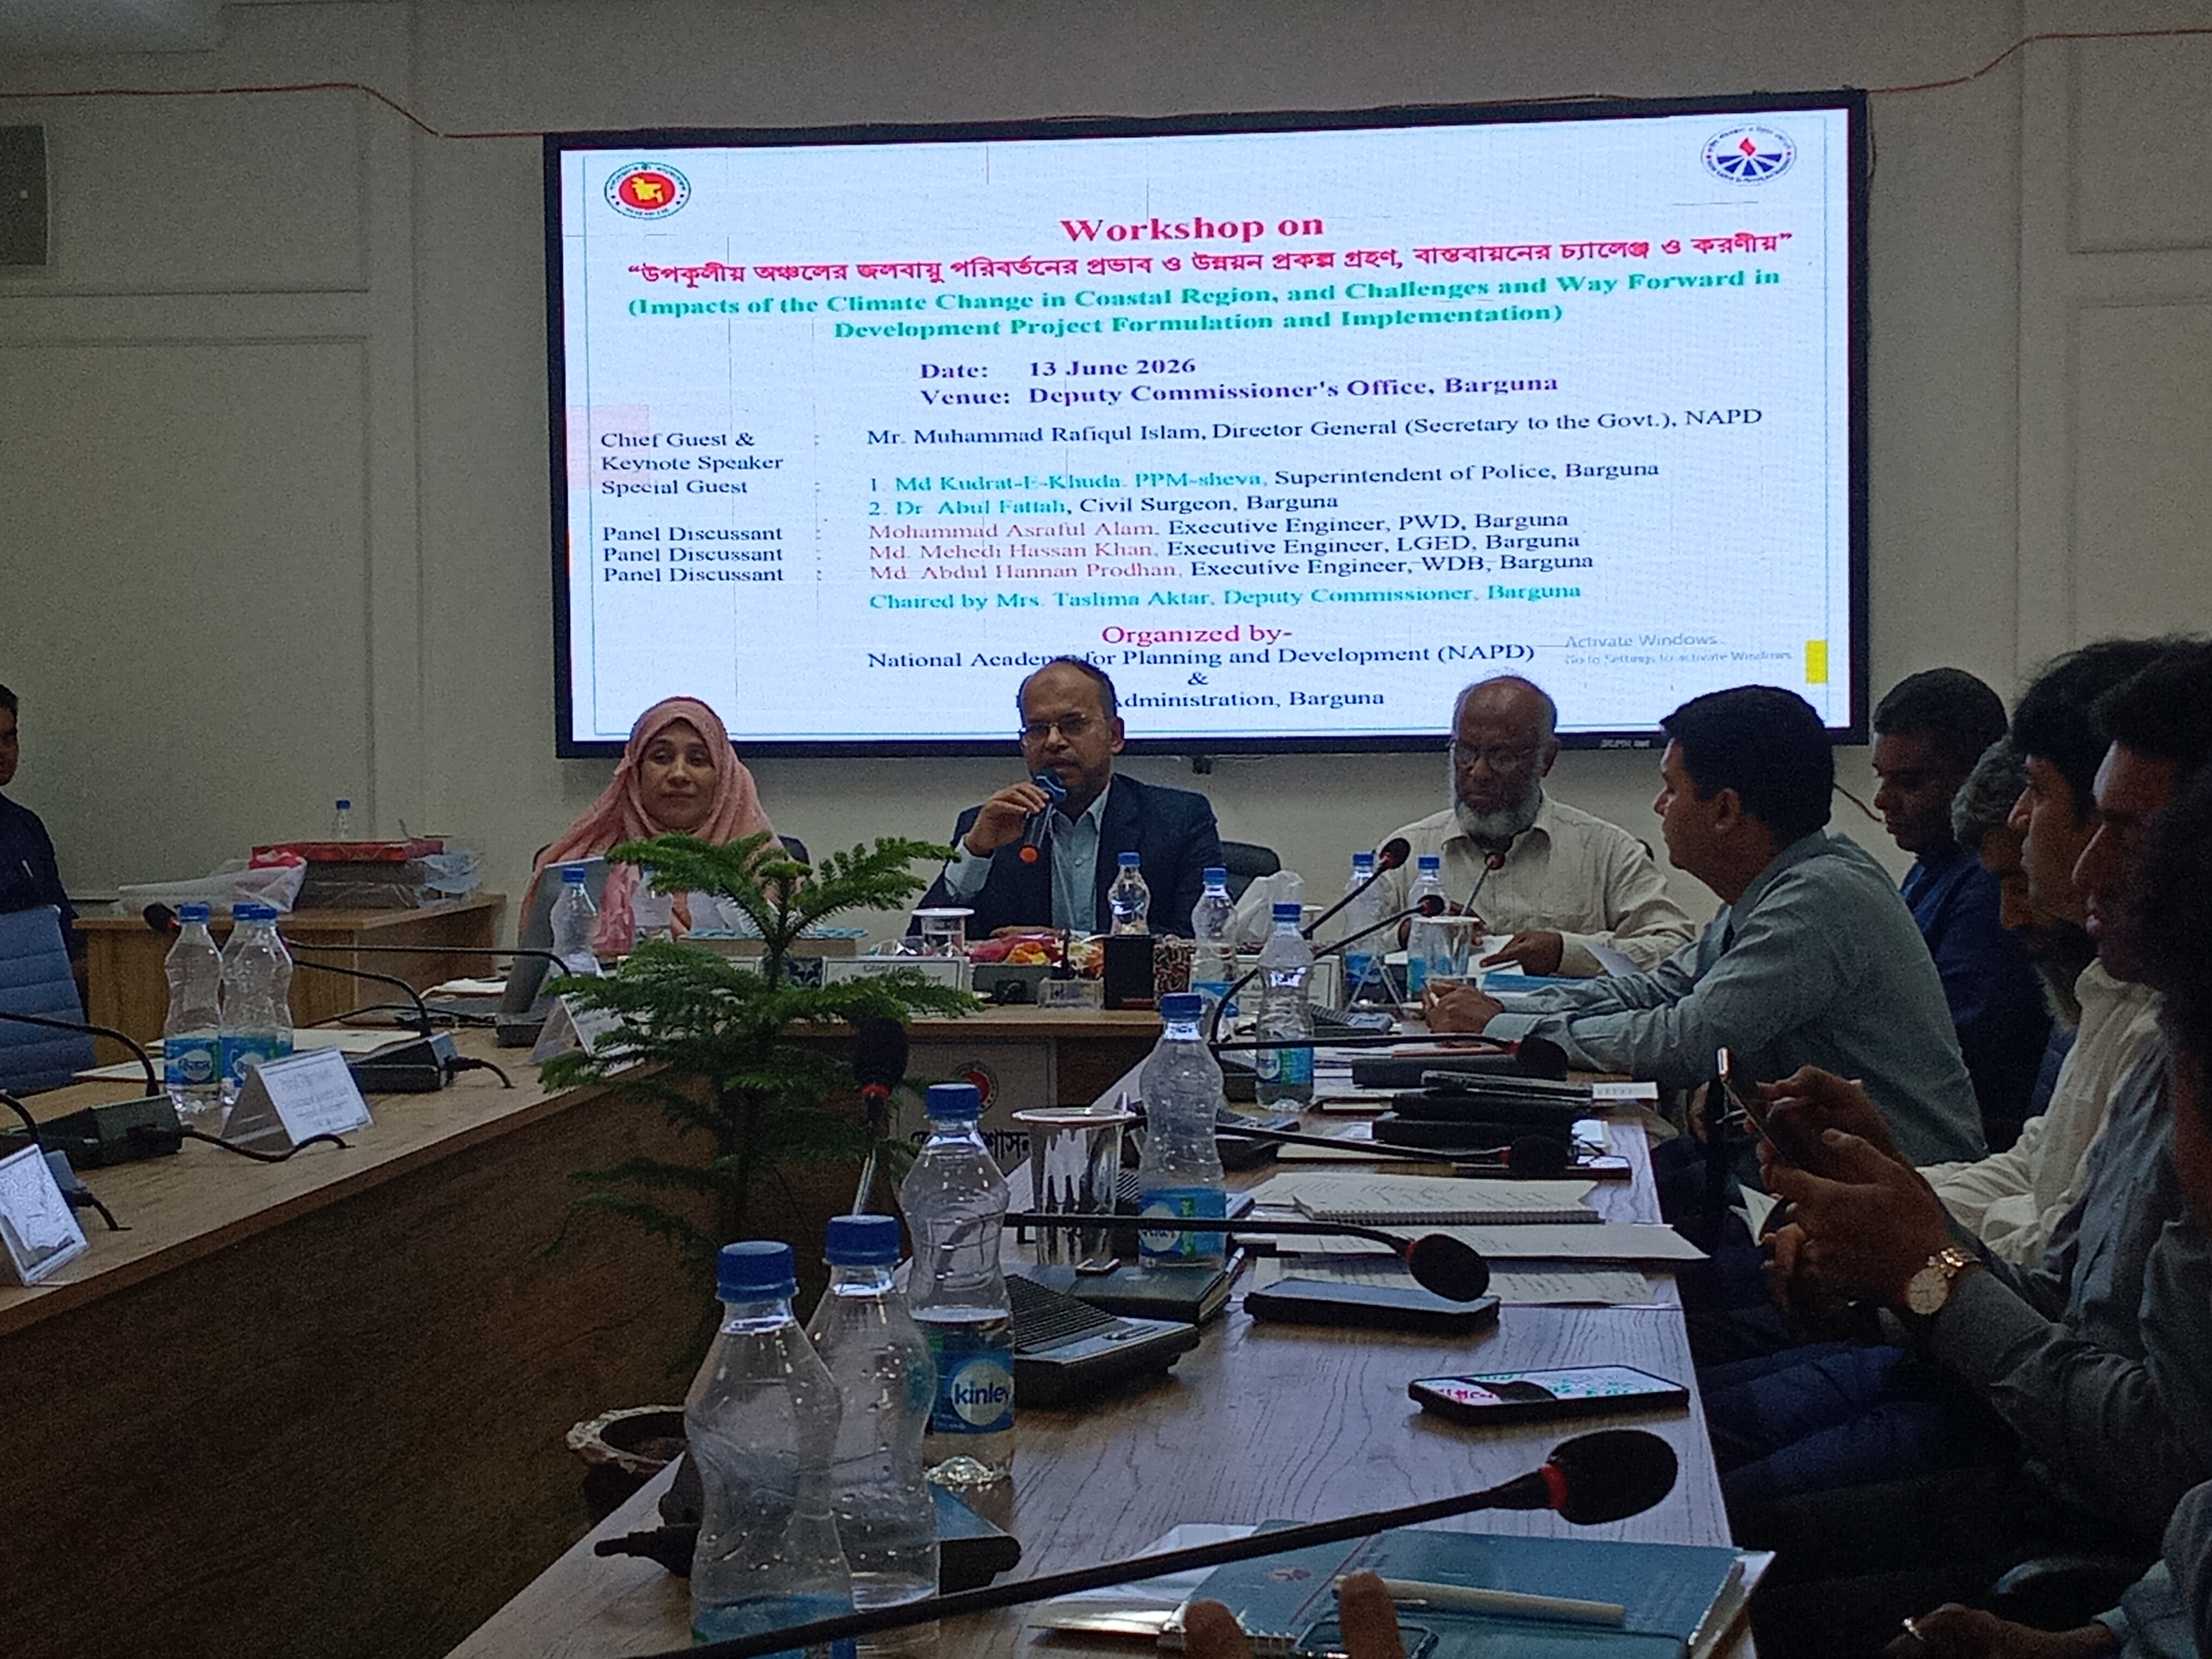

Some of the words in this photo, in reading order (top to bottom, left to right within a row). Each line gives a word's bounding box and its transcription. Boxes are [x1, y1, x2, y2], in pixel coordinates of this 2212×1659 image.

[1059, 216, 1264, 243] Workshop
[1277, 218, 1324, 237] on
[752, 264, 850, 282] অঞ্চলের
[855, 261, 946, 284] জলবায়ু
[949, 254, 1079, 278] পরিবর্তনের
[1086, 256, 1154, 276] প্রভাব
[1161, 256, 1182, 272] ও
[1191, 251, 1265, 272] উন্নয়ন
[1271, 252, 1337, 271] প্রকল্প
[1343, 248, 1403, 269] গ্রহণ,
[1412, 244, 1553, 265] বাস্তবায়নের
[1559, 241, 1650, 261] চ্যালেঞ্জ
[1660, 239, 1682, 255] ও
[627, 298, 741, 319] (Impacts
[747, 297, 775, 314] of
[779, 297, 819, 314] the
[826, 295, 928, 313] Climate
[934, 293, 1034, 313] Change
[1041, 292, 1068, 308] in
[1073, 289, 1173, 307] Coastal
[1180, 286, 1279, 307] Region,
[1287, 284, 1336, 302] and
[1344, 280, 1490, 301] Challenges
[1497, 277, 1548, 294] and
[1555, 275, 1619, 295] Way
[1628, 269, 1746, 291] Forward
[1754, 268, 1782, 285] in
[834, 320, 1002, 341] Development
[1009, 318, 1104, 338] Project
[1111, 313, 1275, 333] Formulation
[1283, 311, 1333, 329] and
[1341, 304, 1564, 330] Implementation)
[921, 363, 988, 379] Date:
[1030, 361, 1057, 377] 13
[1065, 361, 1128, 376] June
[1136, 358, 1196, 375] 2026
[920, 389, 1009, 406] Venue:
[1029, 388, 1122, 407] Deputy
[1130, 381, 1339, 402] Commissioner's
[1347, 379, 1435, 396] Office,
[1445, 377, 1558, 395] Barguna
[914, 427, 1044, 445] Muhammad
[1051, 426, 1131, 445] Rafiqul
[1141, 425, 1207, 441] Islam,
[1212, 423, 1303, 439] Director
[1310, 419, 1397, 436] General
[1405, 418, 1519, 436] (Secretary
[1528, 417, 1549, 430] to
[1556, 414, 1590, 430] the
[1597, 413, 1677, 429] Govt.),
[1684, 408, 1763, 426] NAPD
[601, 433, 662, 448] Chief
[666, 433, 727, 448] Guest
[735, 432, 755, 447] &
[602, 456, 691, 473] Keynote
[698, 455, 784, 473] Speaker
[1275, 467, 1442, 488] Superintendent
[1450, 465, 1476, 481] of
[1481, 464, 1557, 480] Police,
[1565, 463, 1660, 480] Barguna
[602, 479, 678, 498] Special
[686, 479, 748, 494] Guest
[937, 499, 990, 515] Abul
[999, 499, 1072, 515] Fattah,
[1079, 497, 1133, 513] Civil
[1141, 497, 1238, 515] Surgeon,
[1246, 495, 1339, 512] Barguna
[602, 526, 661, 542] Panel
[668, 526, 783, 541] Discussant
[869, 523, 998, 539] Mohammad
[1006, 522, 1085, 537] Asraful
[1168, 518, 1278, 535] Executive
[1285, 517, 1391, 536] Engineer,
[1399, 514, 1467, 531] PWD,
[1474, 513, 1568, 531] Barguna
[603, 547, 660, 562] Panel
[668, 546, 783, 562] Discussant
[921, 541, 1001, 559] Mehedi
[1010, 543, 1086, 558] Hassan
[1167, 539, 1276, 556] Executive
[1283, 539, 1390, 557] Engineer,
[1397, 535, 1477, 552] LGED,
[1486, 534, 1580, 552] Barguna
[604, 567, 661, 582] Panel
[670, 567, 784, 582] Discussant
[921, 565, 987, 580] Abdul
[996, 564, 1077, 578] Hannan
[1191, 559, 1300, 576] Executive
[1307, 558, 1413, 577] Engineer,
[1420, 556, 1491, 573] WDB,
[1500, 554, 1594, 573] Barguna
[869, 593, 956, 609] Chaired
[960, 593, 988, 612] by
[1052, 591, 1140, 607] Taslima
[1224, 589, 1304, 608] Deputy
[1488, 584, 1581, 603] Barguna
[1101, 624, 1240, 648] Organized
[1249, 624, 1293, 646] by-
[1566, 636, 1632, 648] Activate
[867, 652, 962, 668] National
[971, 652, 1076, 667] Acade
[1085, 651, 1116, 665] for
[1122, 650, 1223, 668] Planning
[1229, 648, 1270, 664] and
[1278, 647, 1430, 666] Development
[1437, 644, 1535, 664] (NAPD)
[1187, 671, 1209, 686] &
[1114, 691, 1281, 707] dministration,
[1289, 691, 1385, 709] Barguna
